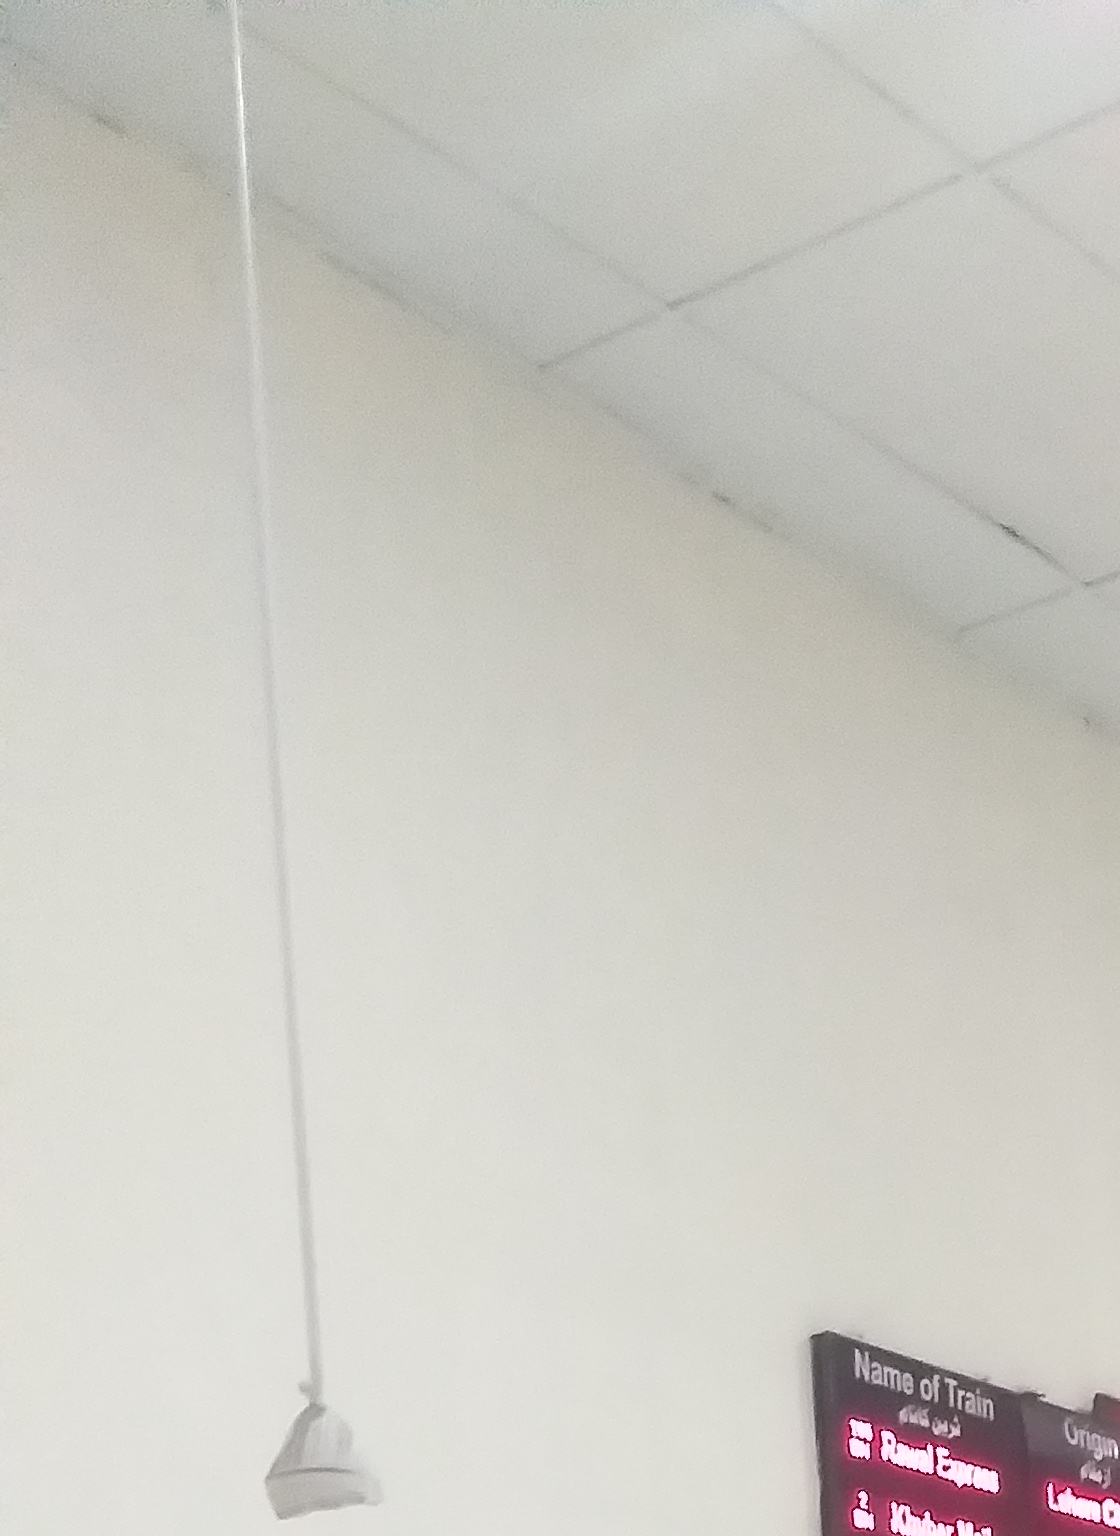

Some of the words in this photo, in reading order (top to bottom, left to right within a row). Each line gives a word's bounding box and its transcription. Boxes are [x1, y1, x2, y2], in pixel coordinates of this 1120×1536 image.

[854, 1348, 914, 1396] Name
[920, 1374, 941, 1403] of
[945, 1378, 995, 1421] Train
[1064, 1418, 1119, 1461] Origin
